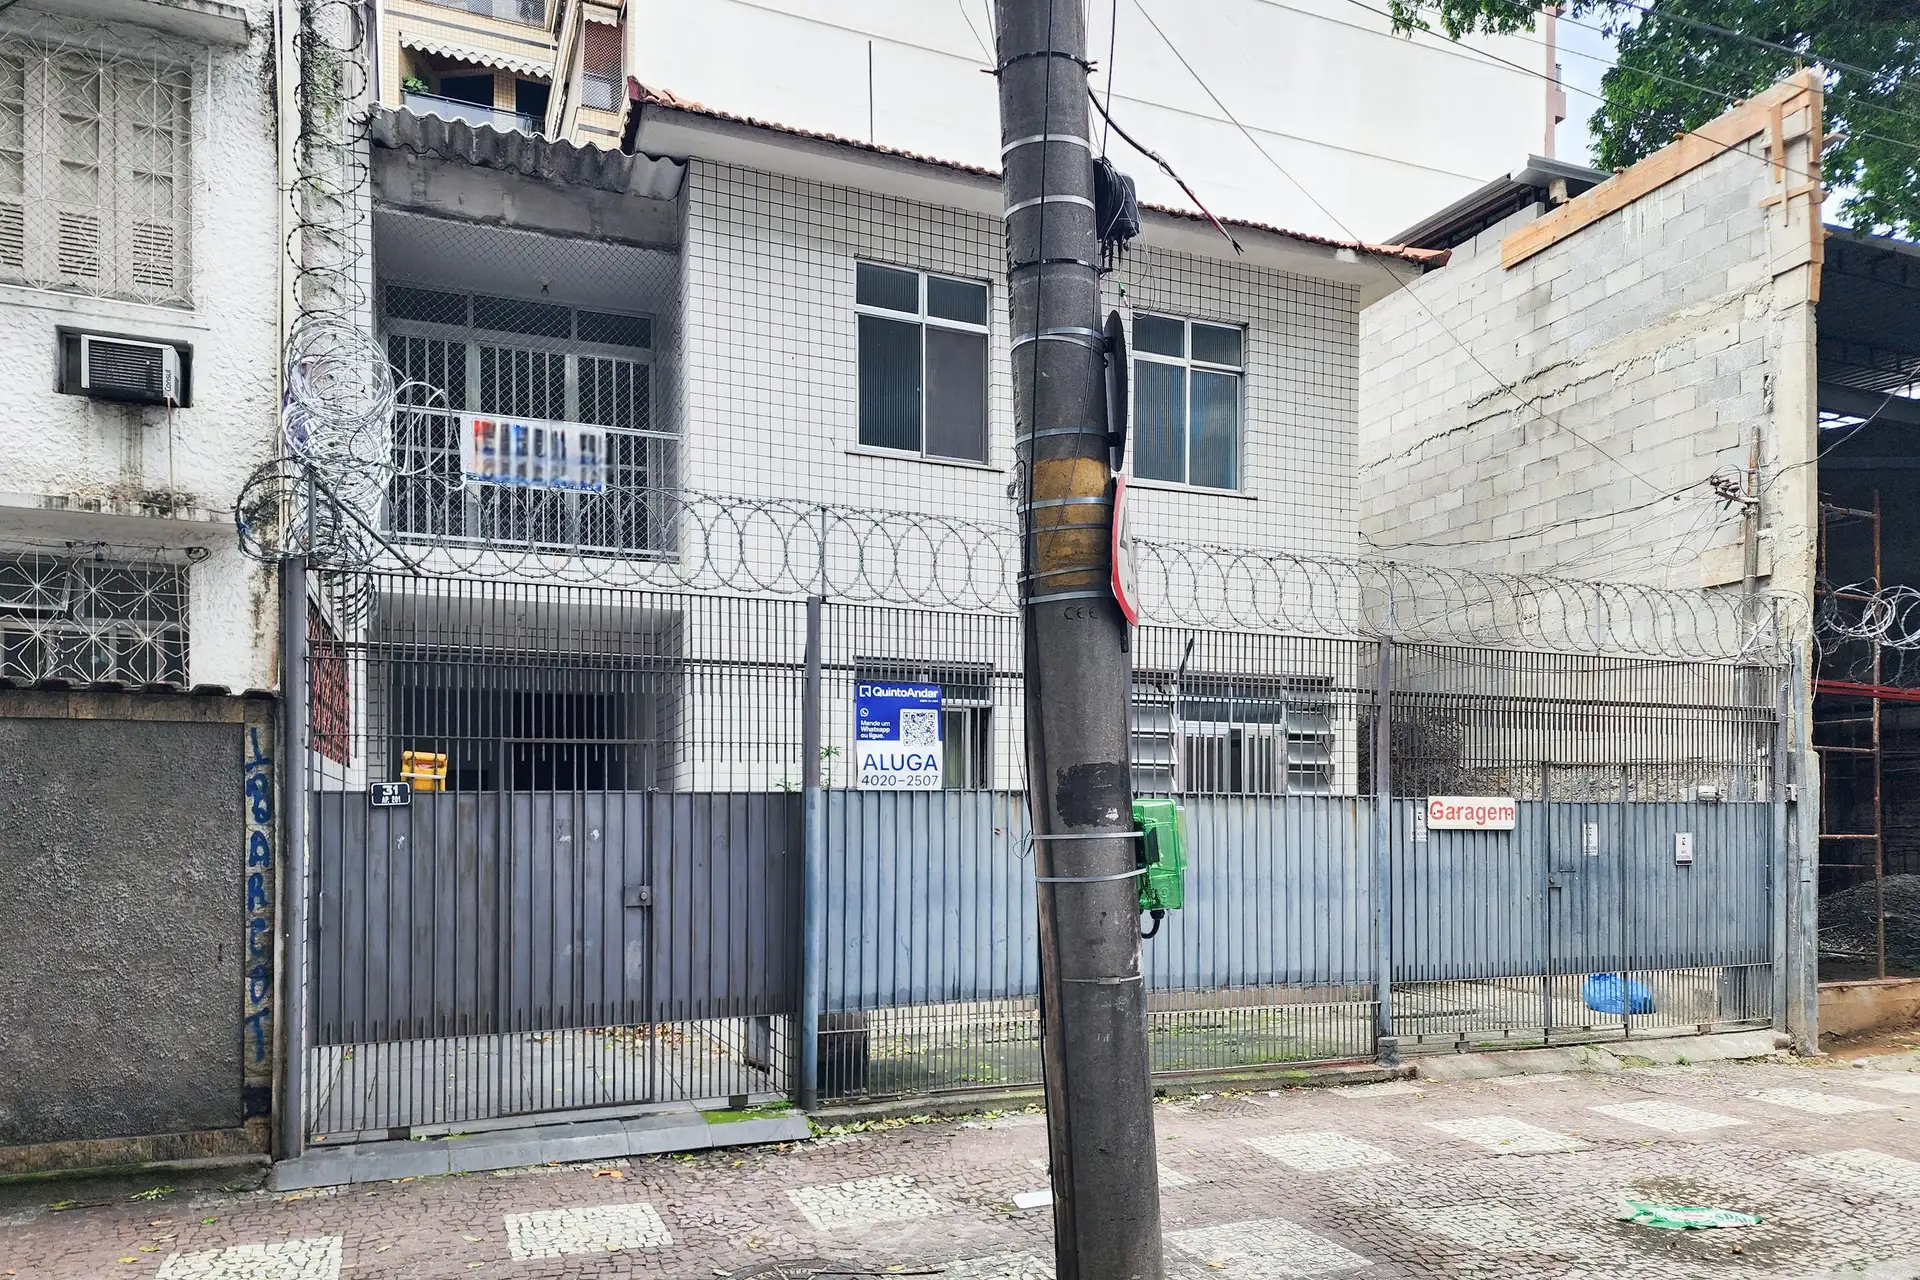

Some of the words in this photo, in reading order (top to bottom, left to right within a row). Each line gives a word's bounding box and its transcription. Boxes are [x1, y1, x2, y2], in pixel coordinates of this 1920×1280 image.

[164, 369, 172, 392] Consul
[872, 686, 939, 698] QuintoAndar
[863, 754, 938, 771] ALUGA
[861, 775, 938, 787] 4020-2507
[382, 784, 399, 796] 31
[1430, 801, 1515, 825] Garagem
